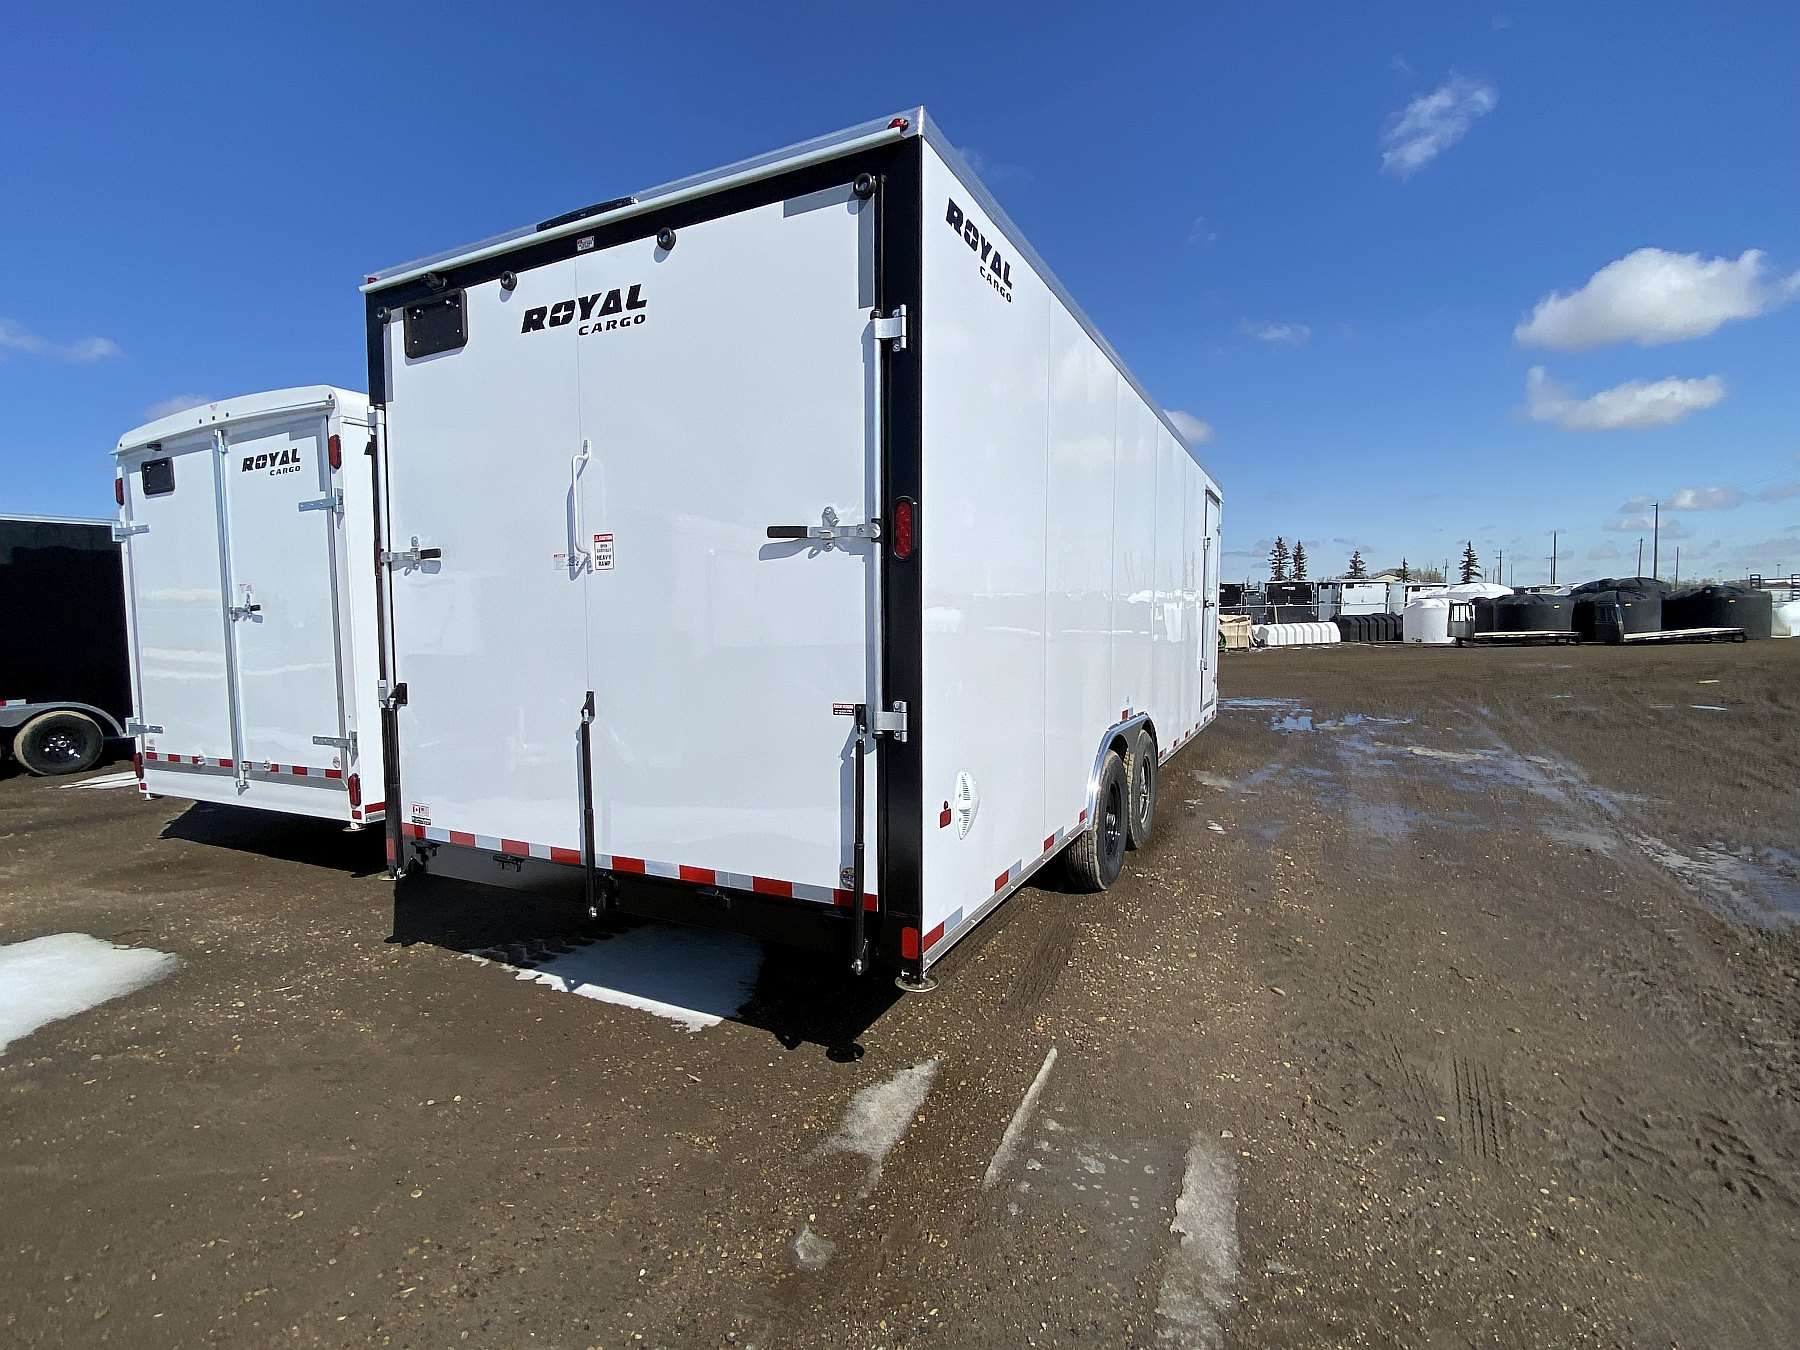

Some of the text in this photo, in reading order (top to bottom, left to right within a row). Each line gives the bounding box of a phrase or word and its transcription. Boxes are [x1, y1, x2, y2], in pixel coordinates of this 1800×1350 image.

[946, 197, 1013, 290] ROYAL
[980, 265, 1012, 303] CARGO
[521, 284, 647, 334] ROYAL
[578, 314, 645, 336] CARGO
[242, 448, 301, 472] ROYAL
[269, 465, 301, 476] CARGO
